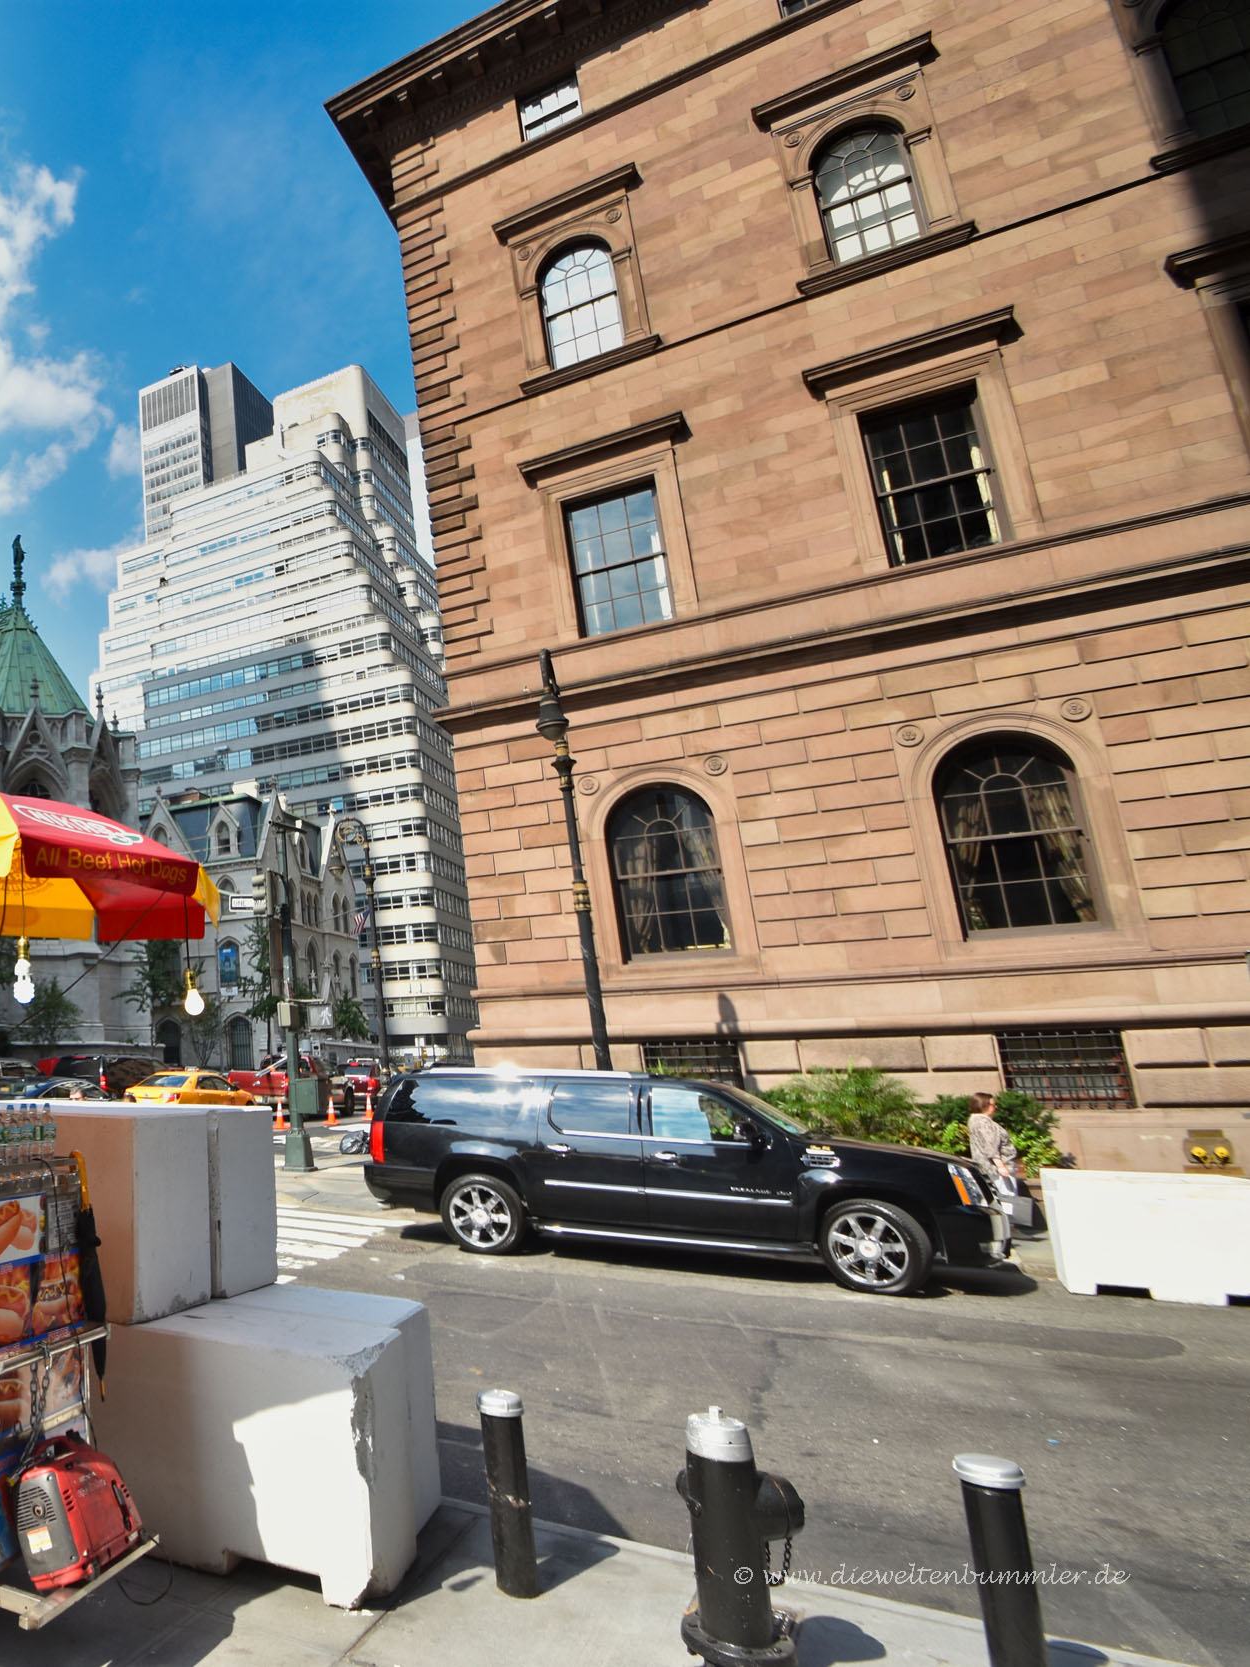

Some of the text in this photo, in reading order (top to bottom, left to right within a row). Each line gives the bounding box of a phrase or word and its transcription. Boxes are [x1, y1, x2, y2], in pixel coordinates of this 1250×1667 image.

[26, 809, 109, 835] NIKAS
[36, 848, 187, 884] All Beef Hot Dogs
